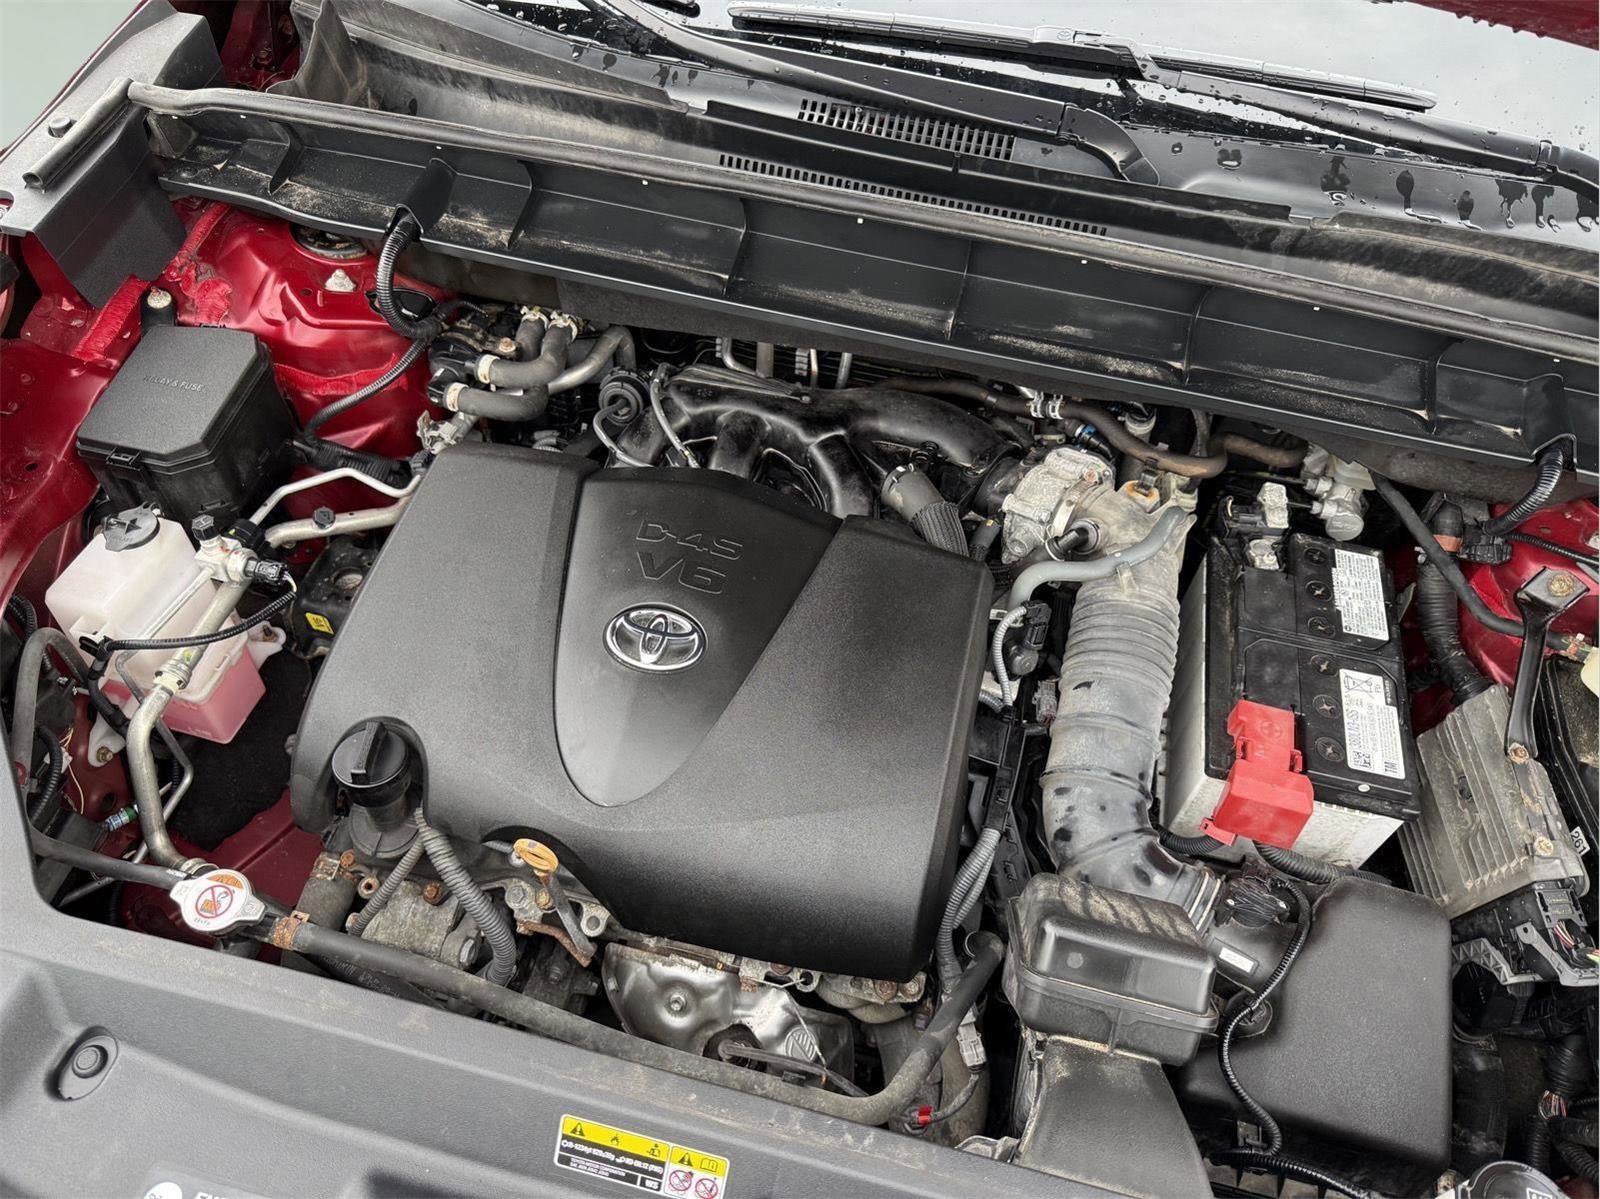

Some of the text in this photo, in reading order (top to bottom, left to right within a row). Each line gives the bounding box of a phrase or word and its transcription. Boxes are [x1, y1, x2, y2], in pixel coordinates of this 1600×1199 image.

[635, 519, 743, 560] D-4S
[636, 551, 727, 595] V6
[1570, 831, 1587, 854] 261
